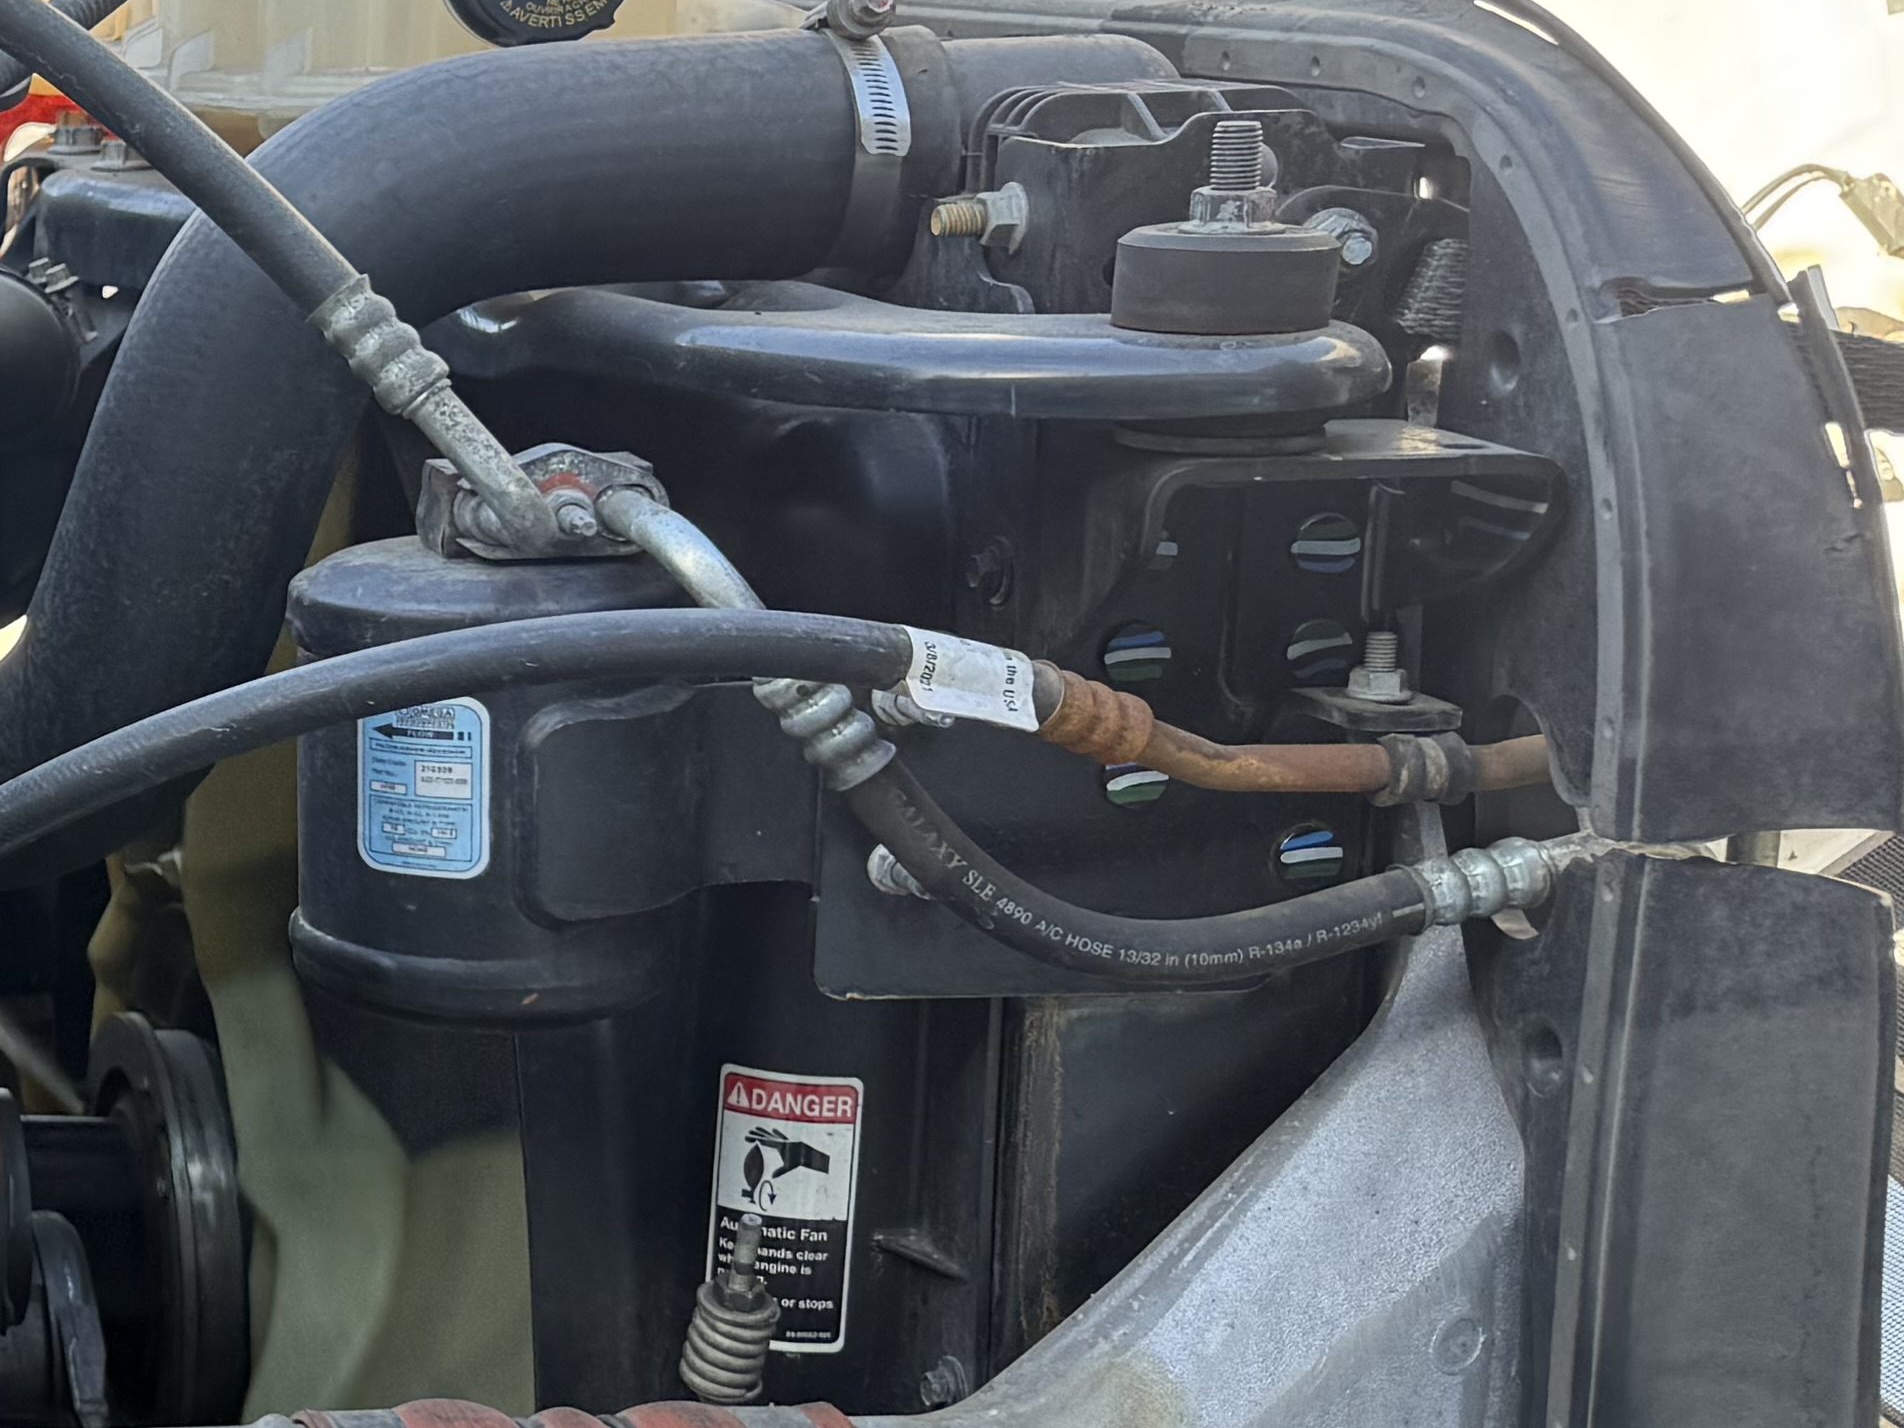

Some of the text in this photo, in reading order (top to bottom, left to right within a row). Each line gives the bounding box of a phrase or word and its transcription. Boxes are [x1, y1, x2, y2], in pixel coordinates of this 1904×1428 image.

[919, 641, 939, 693] 3/8/2021
[1006, 664, 1018, 685] the
[961, 869, 997, 902] SLE
[995, 897, 1034, 926] 4890
[1035, 919, 1065, 942] A/C
[1064, 932, 1115, 960] HOSE
[1117, 948, 1162, 967] 13/32
[1165, 952, 1180, 967] in
[1184, 948, 1244, 969] (10mm)
[1248, 939, 1304, 961] R-134a
[1316, 911, 1384, 945] R-1234yf
[750, 1089, 854, 1119] DANGER
[719, 1215, 828, 1242] Auatic Fan
[795, 1249, 829, 1262] clear
[799, 1263, 812, 1275] is
[780, 1296, 796, 1309] or
[797, 1298, 834, 1312] stops
